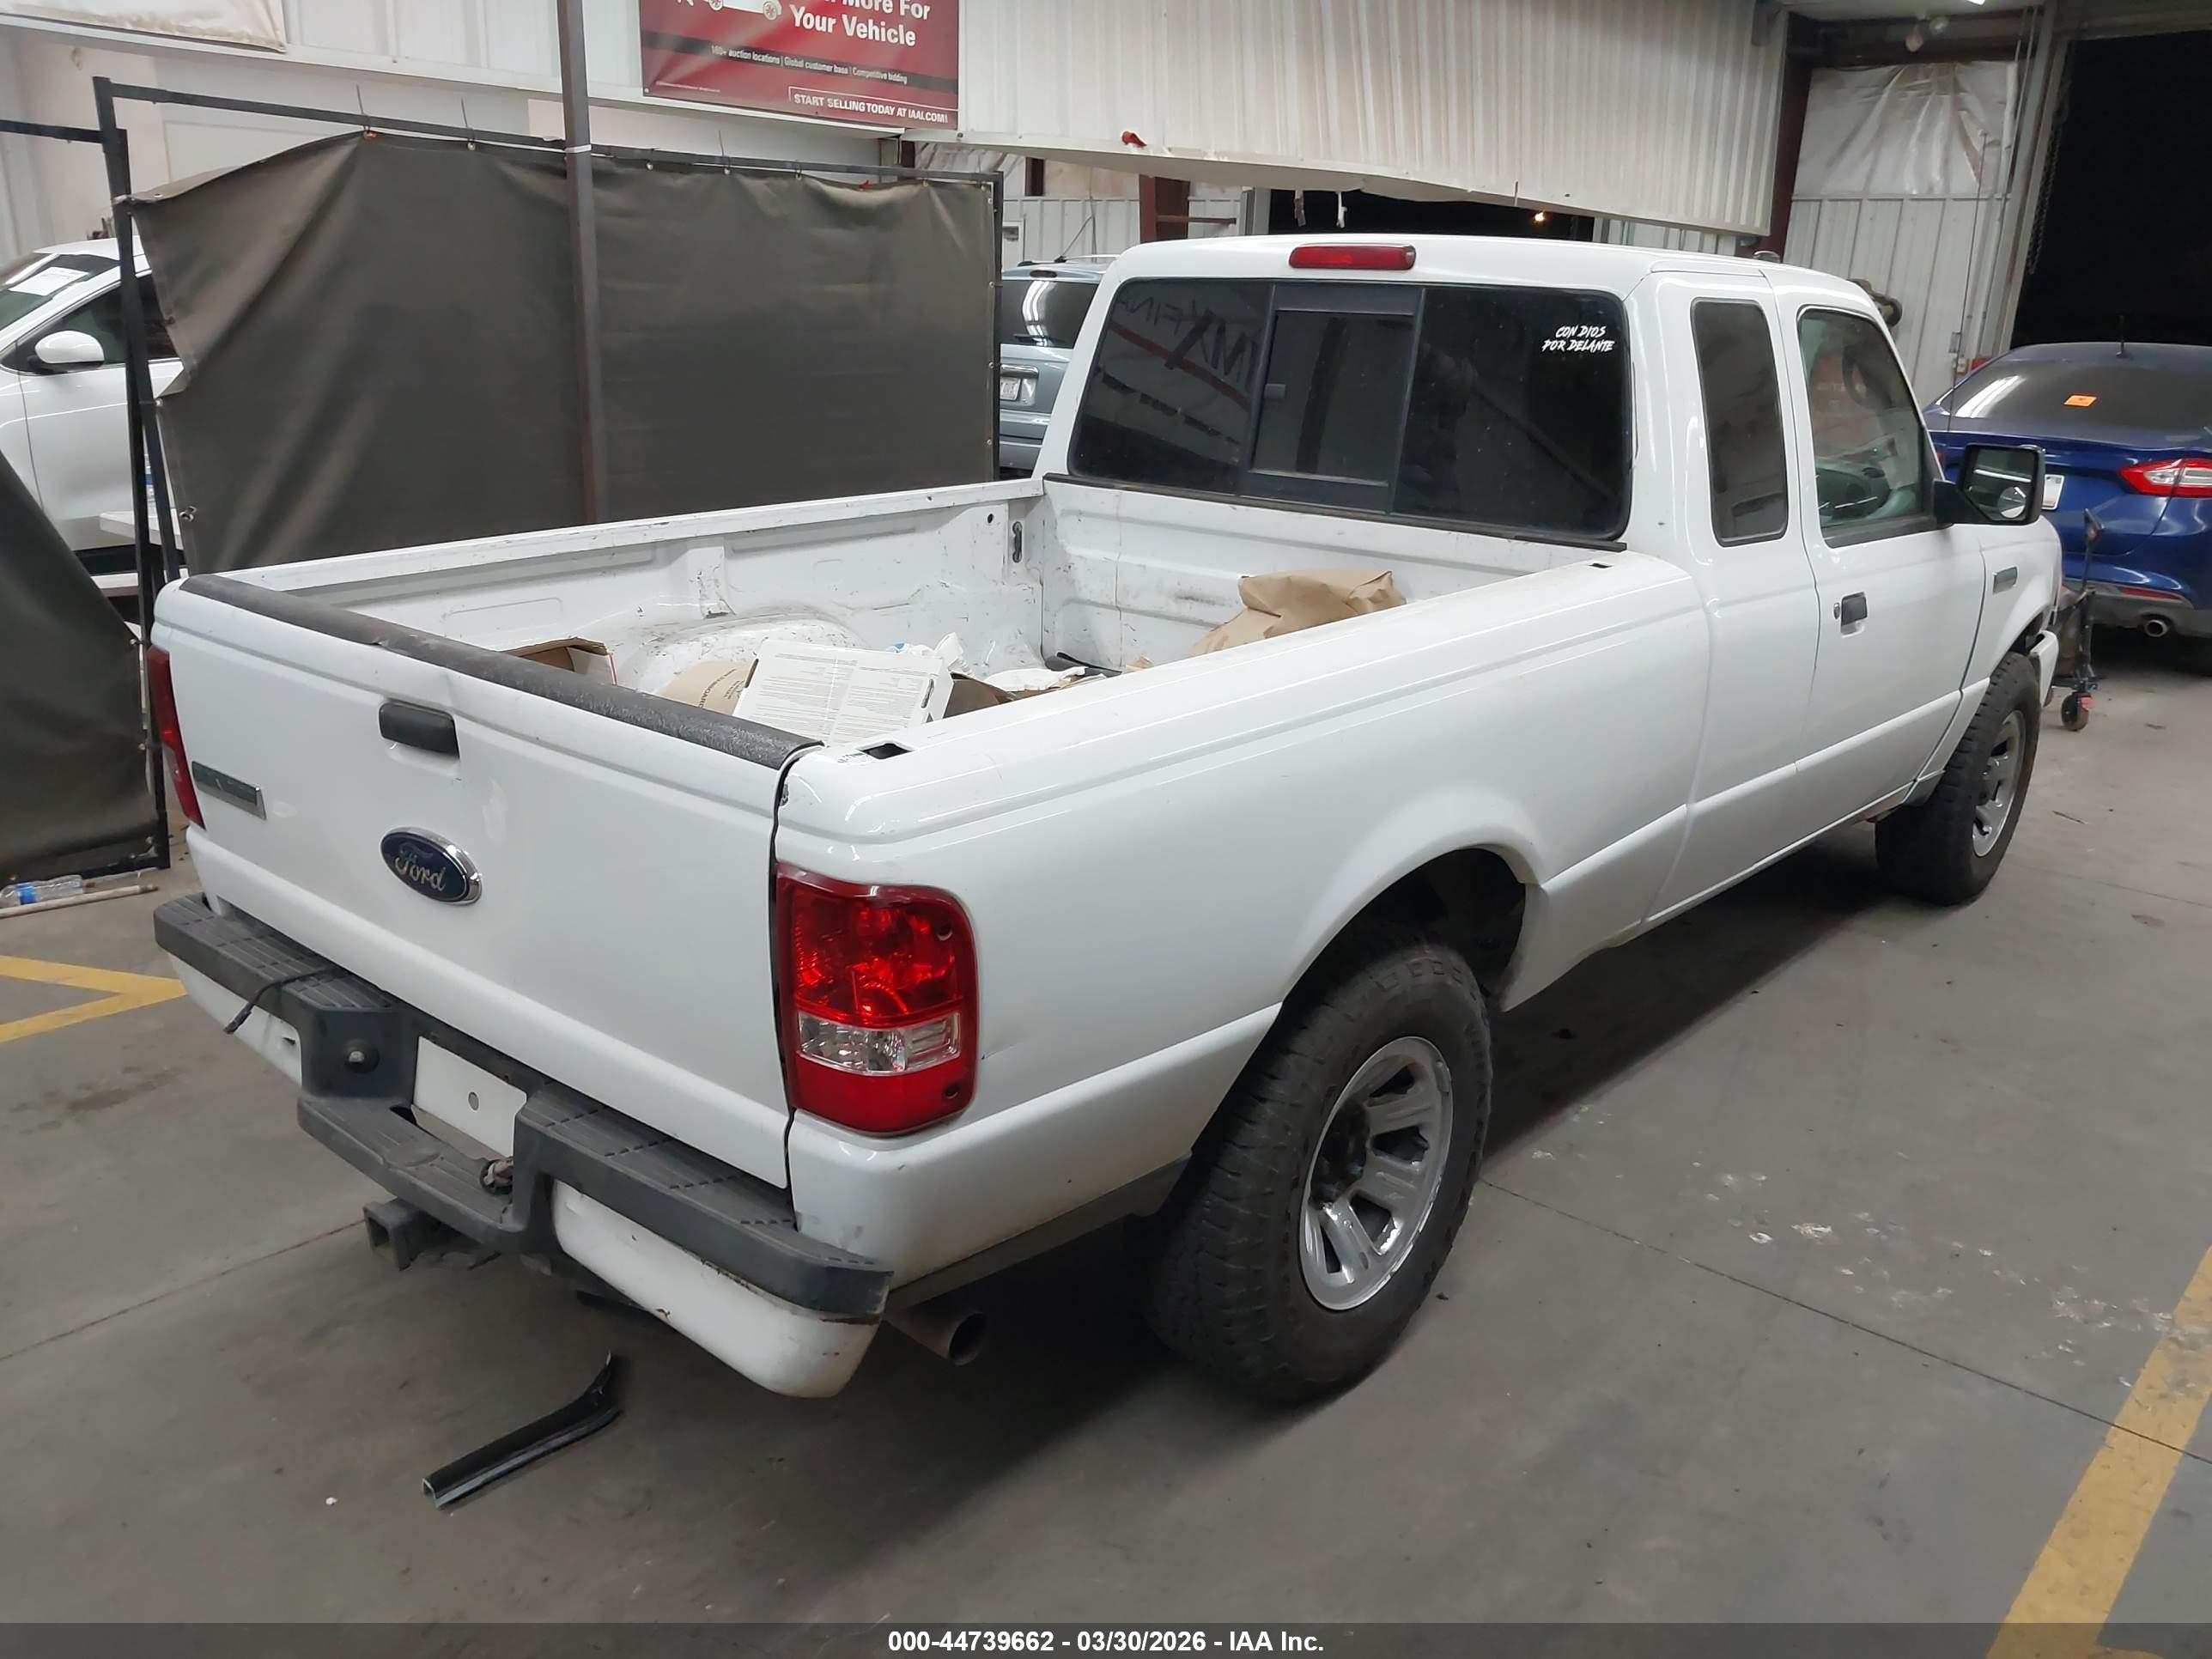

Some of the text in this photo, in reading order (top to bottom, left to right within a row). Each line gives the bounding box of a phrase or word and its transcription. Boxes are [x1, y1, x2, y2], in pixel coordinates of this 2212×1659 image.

[900, 0, 930, 20] For
[789, 4, 915, 46] Your Vehicle
[728, 49, 751, 59] auction
[752, 51, 780, 64] locations
[793, 94, 824, 106] START
[827, 98, 865, 112] SELLING
[866, 102, 896, 116] TODAY
[896, 107, 907, 118] AT
[1555, 324, 1607, 338] CON DIOS
[1541, 338, 1614, 353] POR DELANTE
[395, 842, 446, 891] Ford
